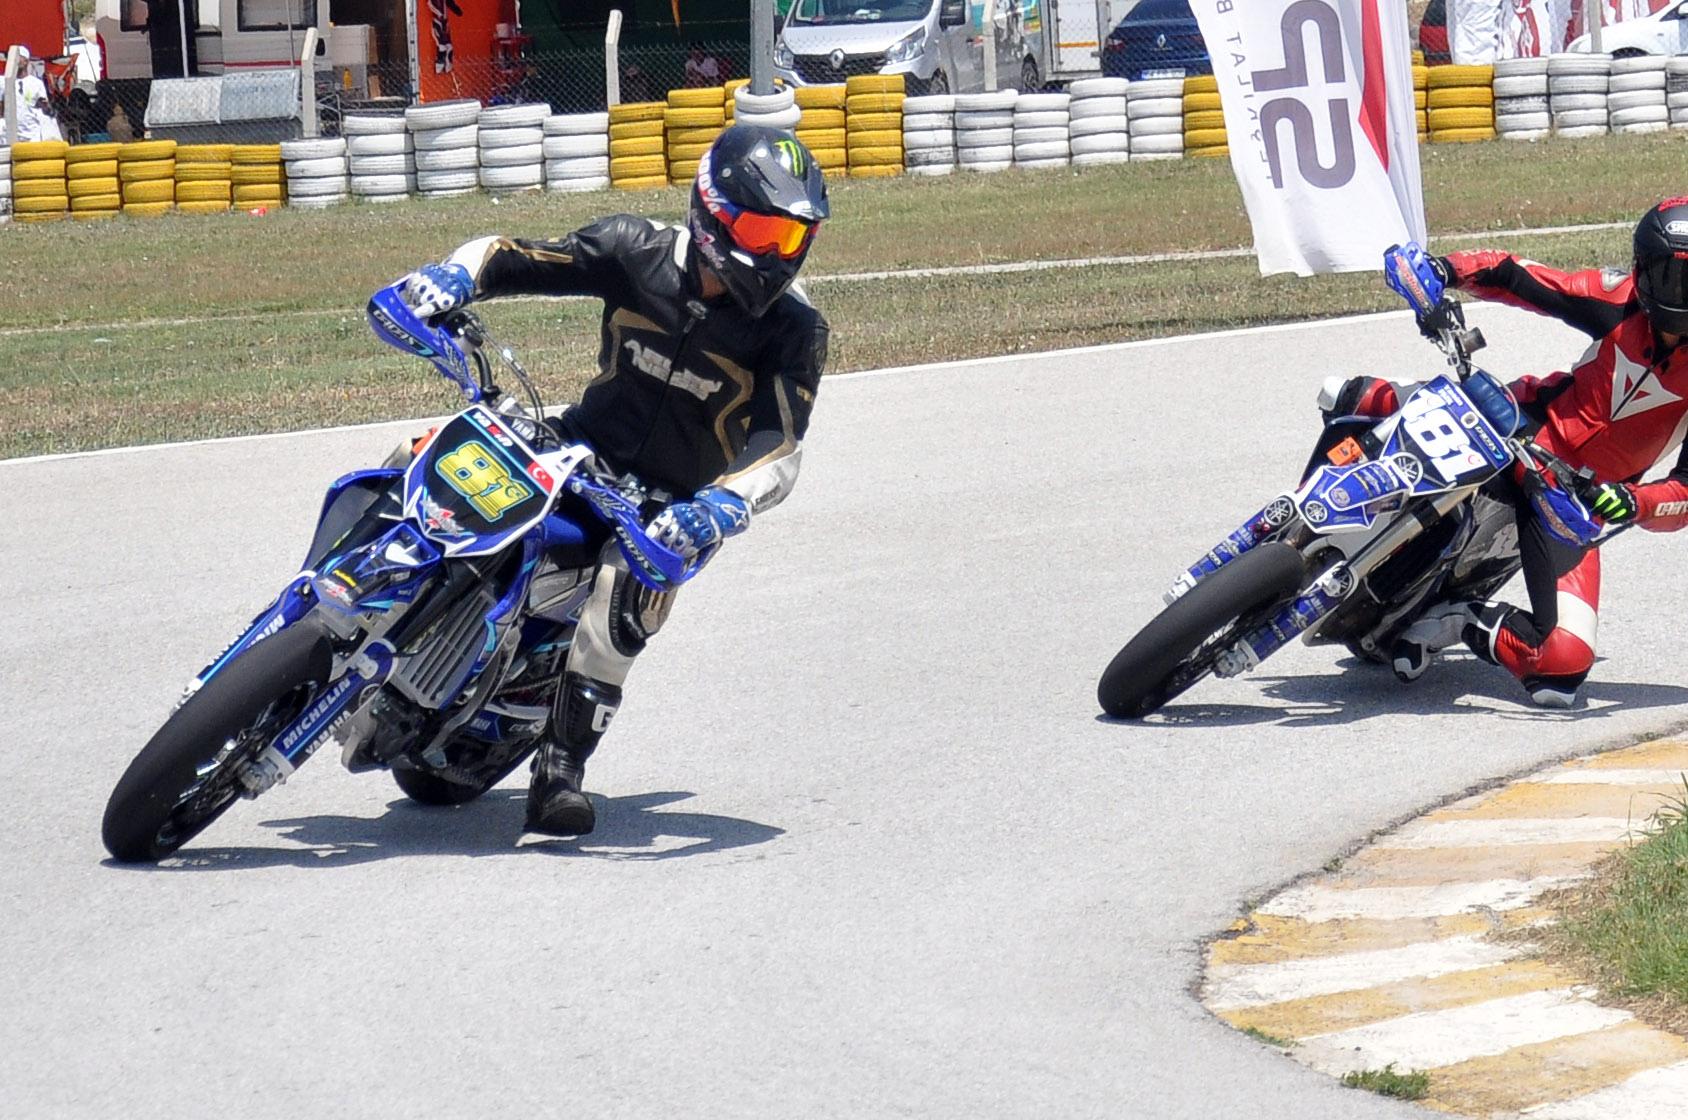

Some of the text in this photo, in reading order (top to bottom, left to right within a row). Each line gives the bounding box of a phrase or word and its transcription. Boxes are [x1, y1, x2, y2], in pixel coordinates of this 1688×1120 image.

[1400, 388, 1489, 483] 181
[435, 439, 535, 523] 81
[282, 677, 352, 750] MICHELIN
[304, 710, 352, 755] YAMAHA
